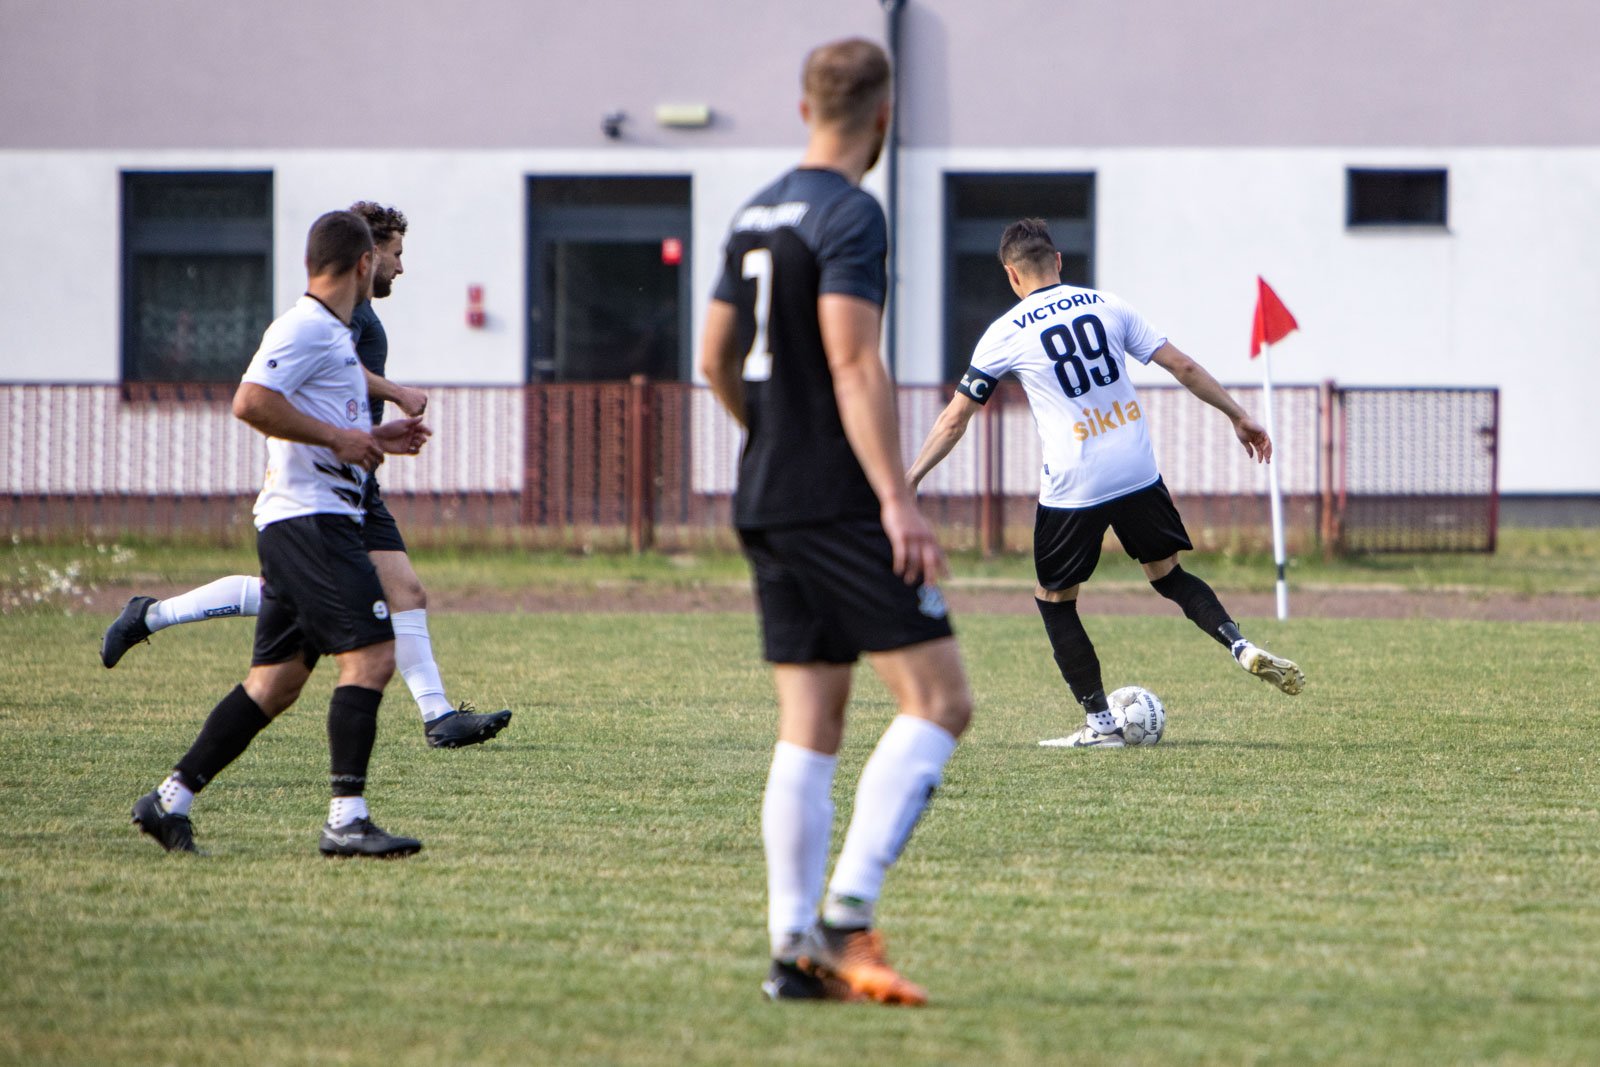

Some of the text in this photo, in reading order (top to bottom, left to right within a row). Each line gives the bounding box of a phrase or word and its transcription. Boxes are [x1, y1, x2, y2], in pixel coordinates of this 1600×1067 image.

[1013, 293, 1105, 329] VICTORIA
[1040, 313, 1120, 399] 89
[1073, 399, 1142, 441] sikla
